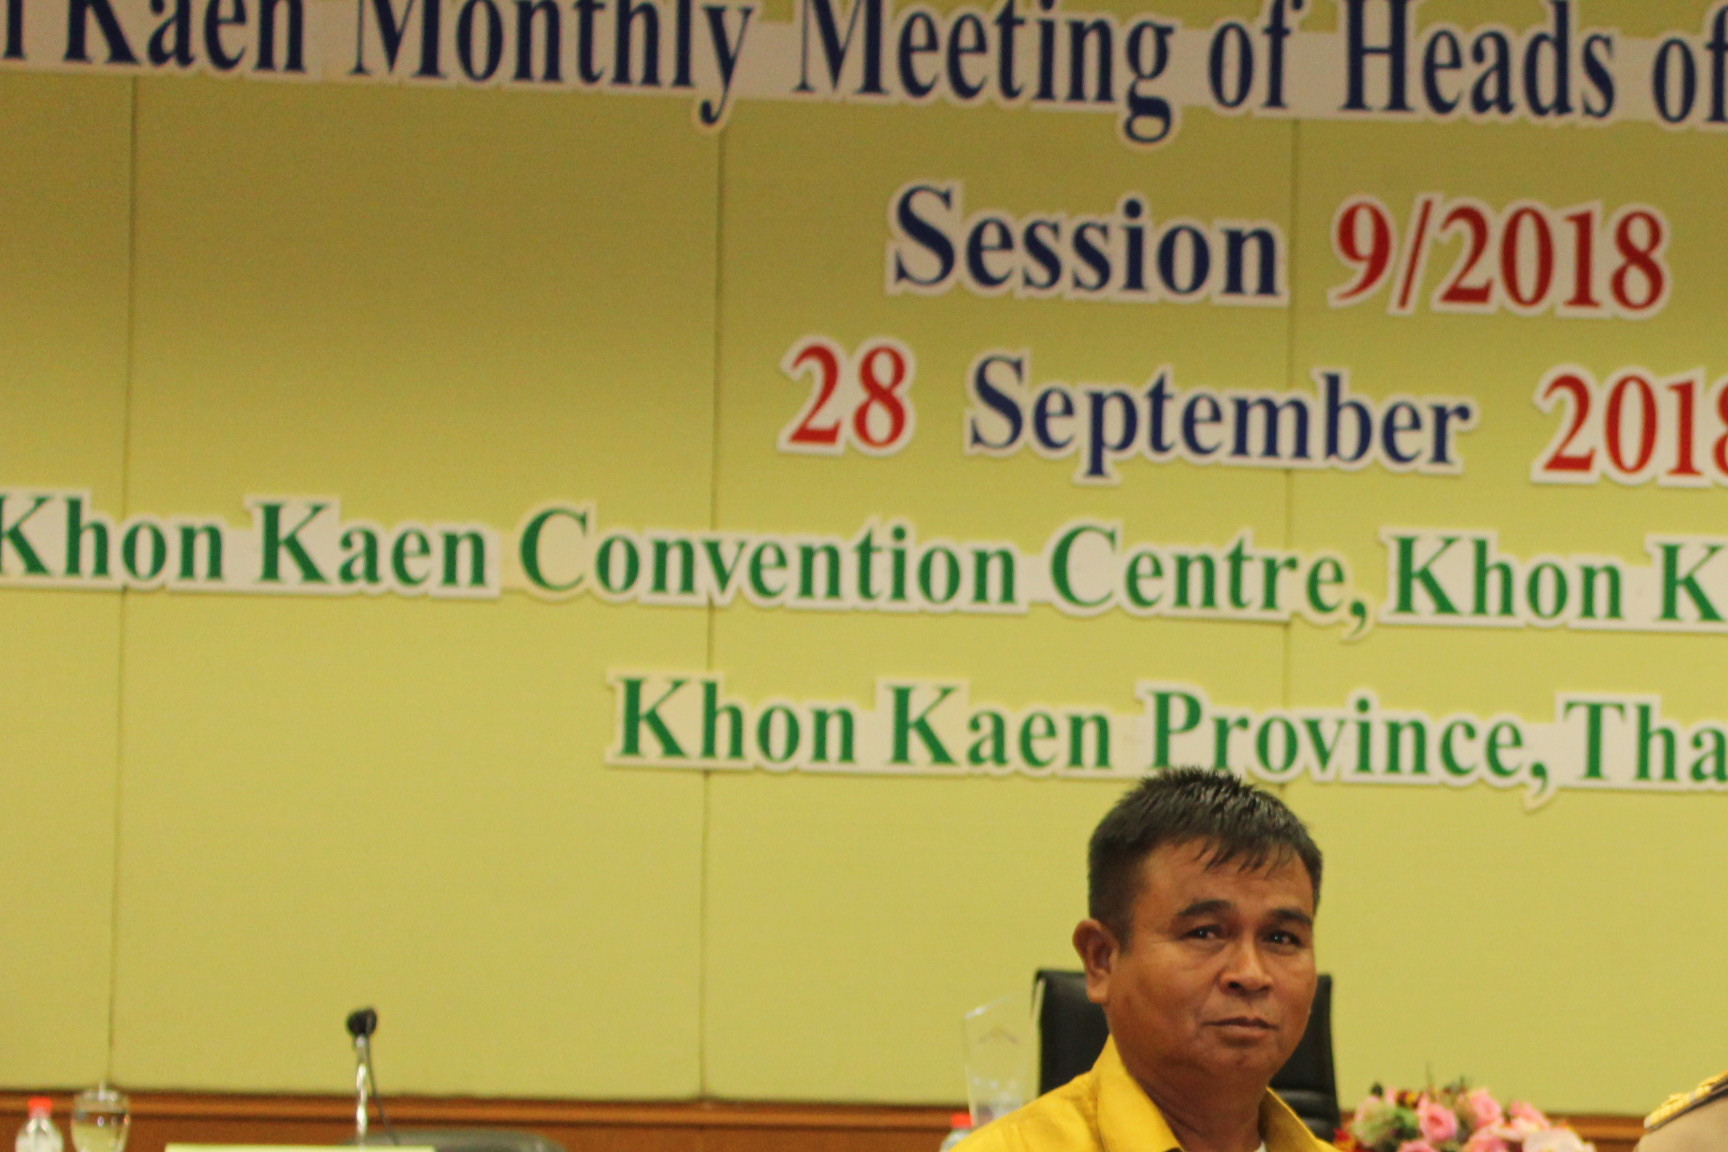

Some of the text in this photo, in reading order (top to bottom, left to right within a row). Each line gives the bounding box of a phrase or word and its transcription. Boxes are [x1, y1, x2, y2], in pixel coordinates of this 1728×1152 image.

[63, 0, 306, 74] Kaen
[350, 0, 754, 127] Monthly
[795, 0, 1175, 145] Meeting
[1208, 0, 1304, 110] of
[1342, 0, 1616, 120] Heads
[895, 186, 1664, 310] Session 9/2018
[790, 344, 906, 447] 28
[971, 356, 1471, 477] September
[0, 495, 223, 580] Khon
[260, 503, 486, 587] Kaen
[519, 508, 1015, 604] Convention
[1050, 526, 1368, 635] Centre,
[1395, 536, 1622, 619] Khon
[621, 678, 855, 763] Khon
[891, 686, 1110, 768] Kaen
[1149, 690, 1549, 796] Province,
